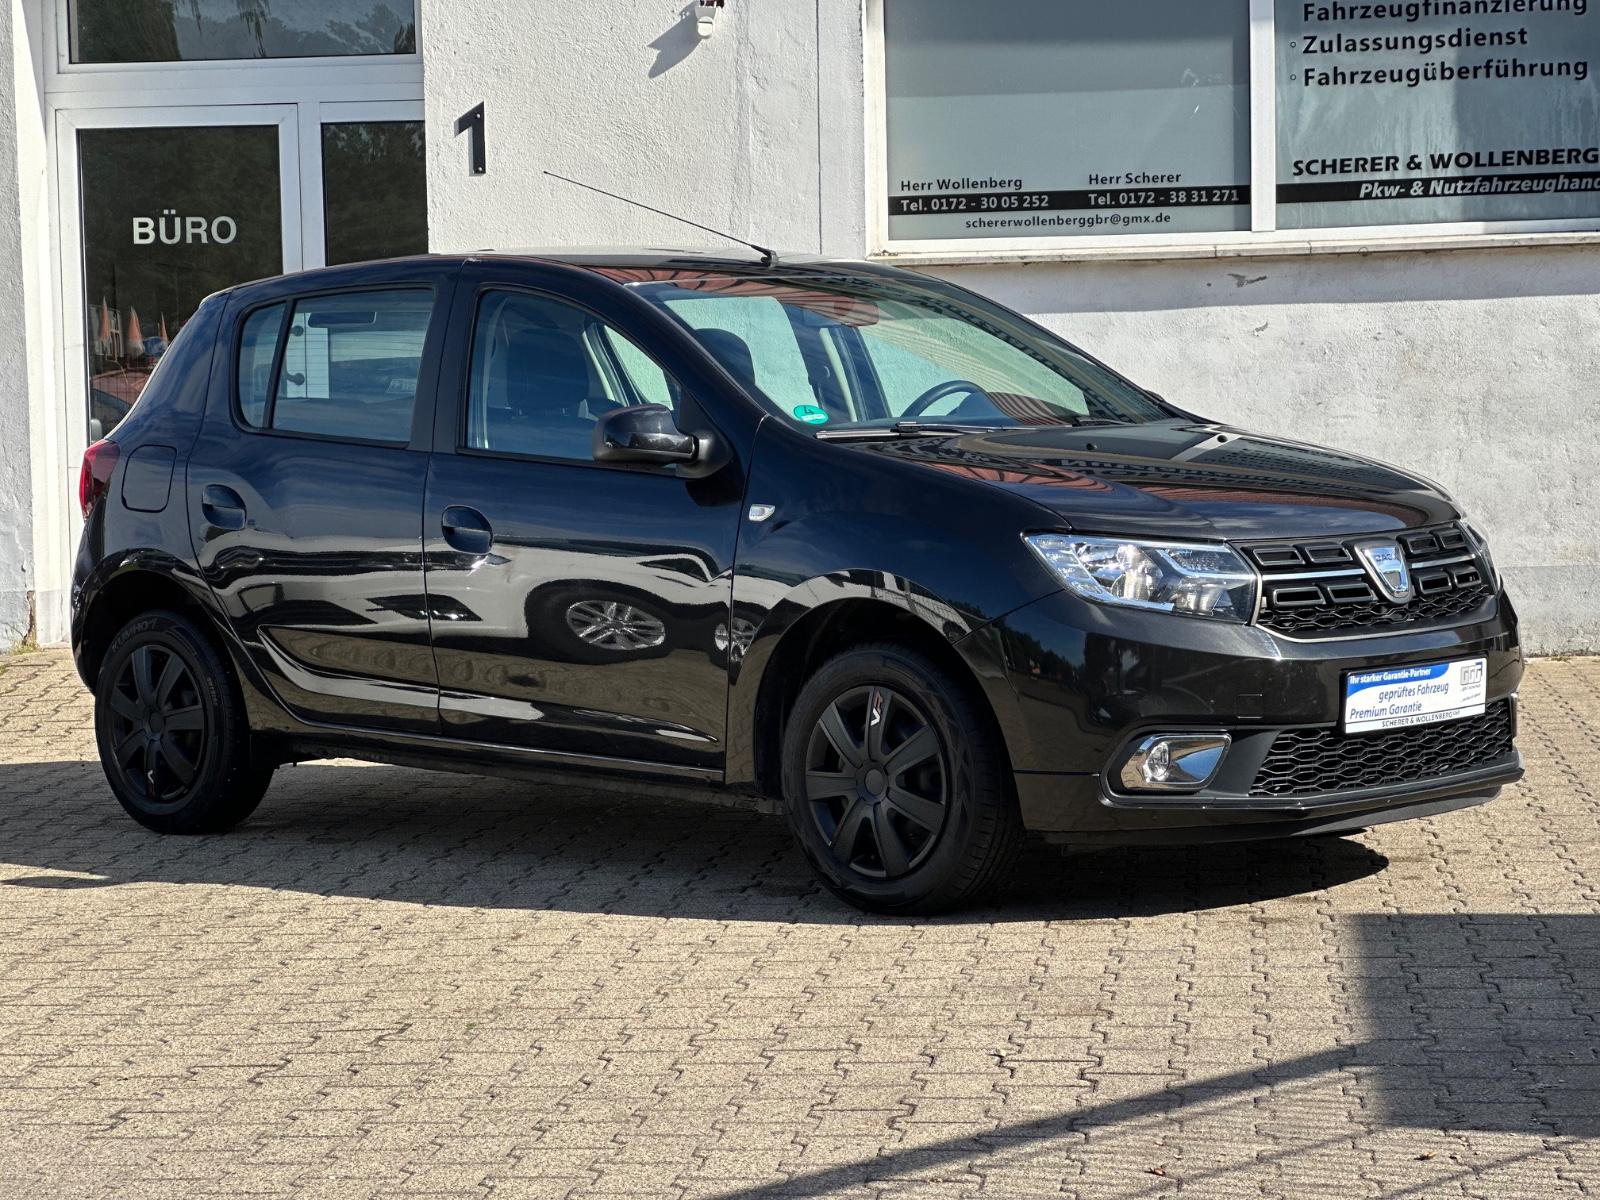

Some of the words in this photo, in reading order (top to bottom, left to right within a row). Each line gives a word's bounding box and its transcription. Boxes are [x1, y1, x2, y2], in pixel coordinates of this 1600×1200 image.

[1303, 0, 1587, 22] Fahrzeugfinanzierung
[1302, 27, 1528, 54] Zulassungsdienst
[1303, 59, 1588, 87] Fahrzeugüberführung
[455, 101, 486, 174] 1
[1293, 156, 1399, 176] SCHERER
[1406, 154, 1422, 171] &
[1430, 147, 1599, 170] WOLLENBERG
[901, 179, 933, 192] Herr
[937, 177, 1023, 191] Wollenberg
[1088, 173, 1122, 185] Herr
[1125, 171, 1182, 184] Scherer
[1088, 192, 1116, 206] Tel.
[1119, 191, 1155, 205] 0172
[1169, 190, 1188, 203] 38
[1190, 189, 1208, 202] 31
[1212, 189, 1240, 202] 271
[1360, 183, 1406, 199] Pkw-
[1410, 181, 1424, 196] &
[901, 199, 928, 212] Tel.
[931, 198, 967, 211] 0172
[980, 197, 998, 209] 30
[1000, 196, 1019, 209] 05
[1022, 195, 1049, 208] 252
[132, 209, 237, 245] BÜRO
[965, 212, 1171, 228] schererwollenberggbr@gmx.de
[1350, 675, 1360, 684] Ihr
[1360, 673, 1382, 683] starker
[1383, 668, 1431, 681] Garantie-Partner
[1378, 687, 1416, 703] geprüftes
[1417, 682, 1449, 696] Fahrzeug
[1350, 705, 1388, 720] Premium
[1389, 701, 1422, 716] Garantie
[1382, 718, 1410, 728] SCHERER
[1415, 712, 1453, 723] WOLLENBERG
